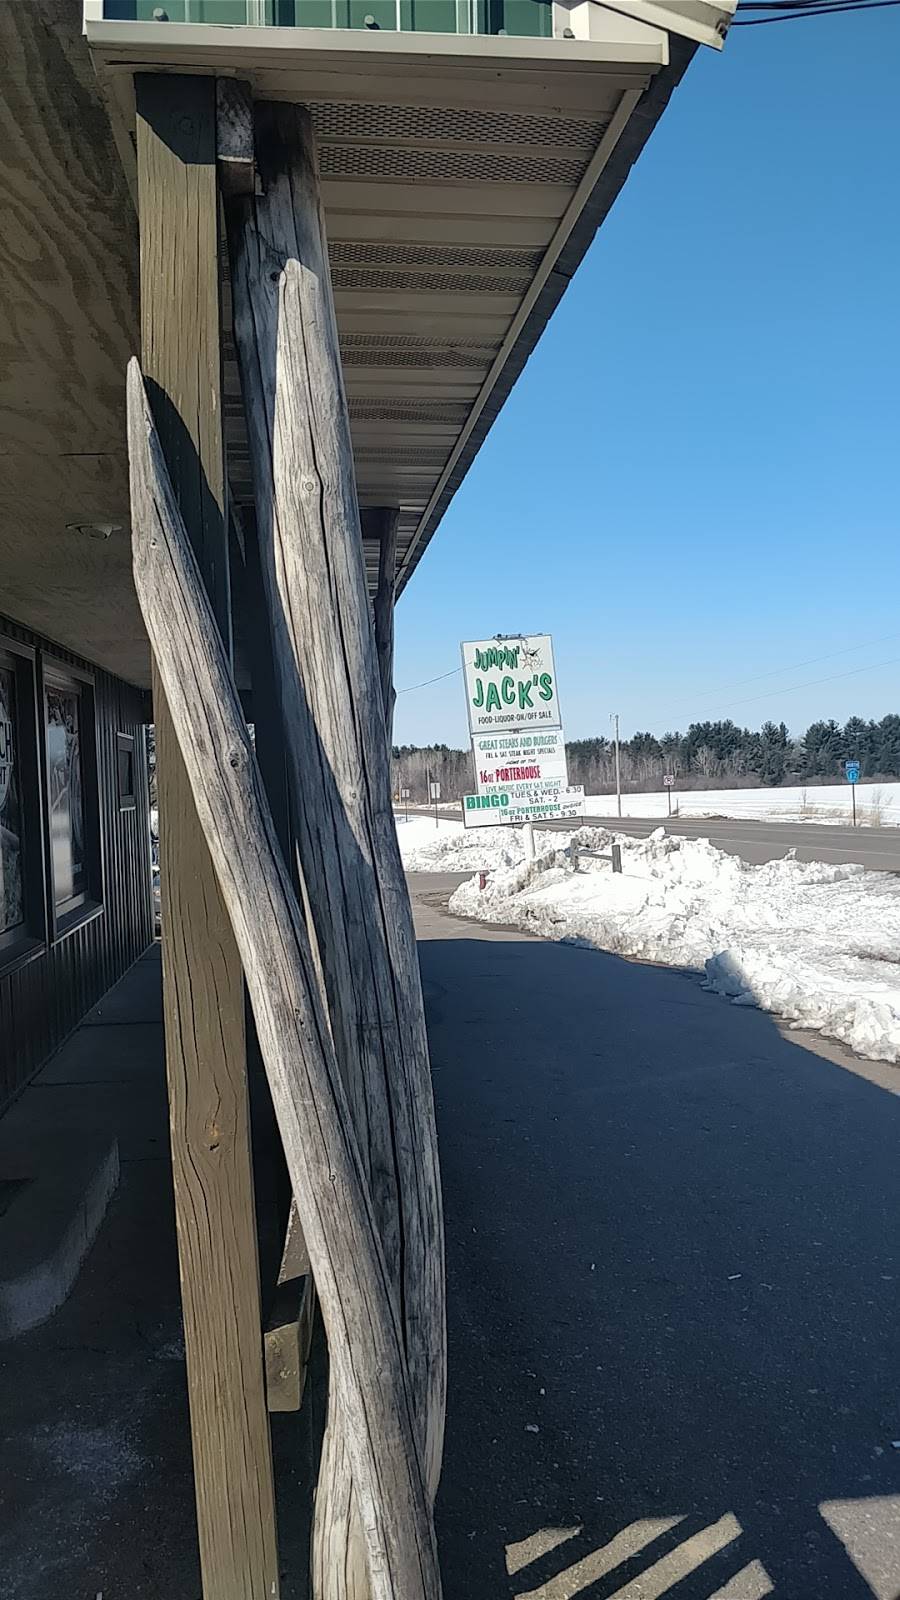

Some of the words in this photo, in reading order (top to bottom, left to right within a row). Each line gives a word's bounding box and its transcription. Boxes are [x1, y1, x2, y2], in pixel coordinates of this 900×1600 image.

[474, 646, 520, 672] JUMPIN'
[473, 673, 553, 712] JACK'S
[479, 739, 498, 750] GREAT
[499, 738, 518, 749] STEAKS
[520, 737, 532, 747] AND
[534, 736, 557, 746] BURGERS
[495, 765, 541, 782] PORTERHOUSE
[486, 785, 497, 793] LIVE
[499, 784, 514, 792] MUSIC
[466, 794, 509, 809] BINGO
[517, 804, 561, 815] PORTERHOUSE
